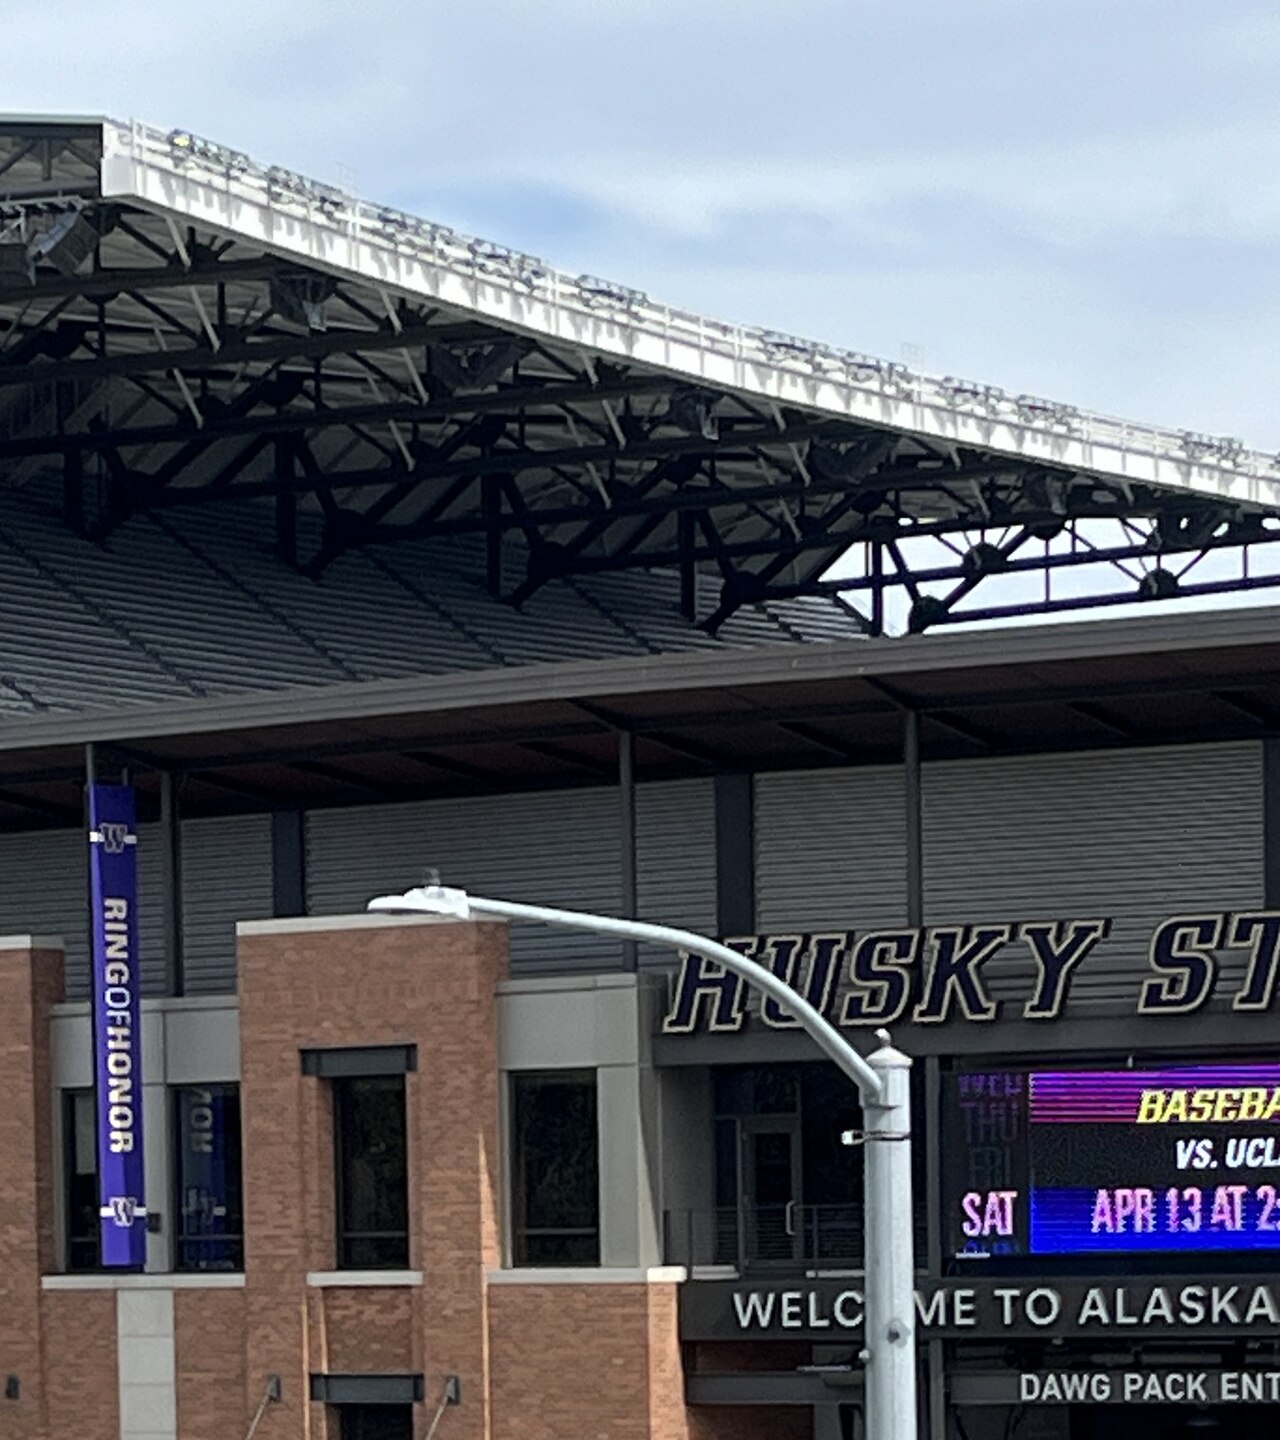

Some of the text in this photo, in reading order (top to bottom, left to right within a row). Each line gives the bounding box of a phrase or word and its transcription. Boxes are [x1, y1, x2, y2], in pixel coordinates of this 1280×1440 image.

[662, 919, 1110, 1032] HUSKY
[1176, 1138, 1218, 1170] VS.
[962, 1191, 1018, 1236] SAT
[1091, 1189, 1156, 1233] APR
[1166, 1188, 1202, 1233] 13
[1211, 1185, 1248, 1231] AT
[733, 1290, 977, 1328] WELCME
[994, 1288, 1060, 1325] TO
[1078, 1285, 1280, 1325] ALASKA
[1021, 1373, 1111, 1401] DAWG
[1124, 1373, 1208, 1400] PACK
